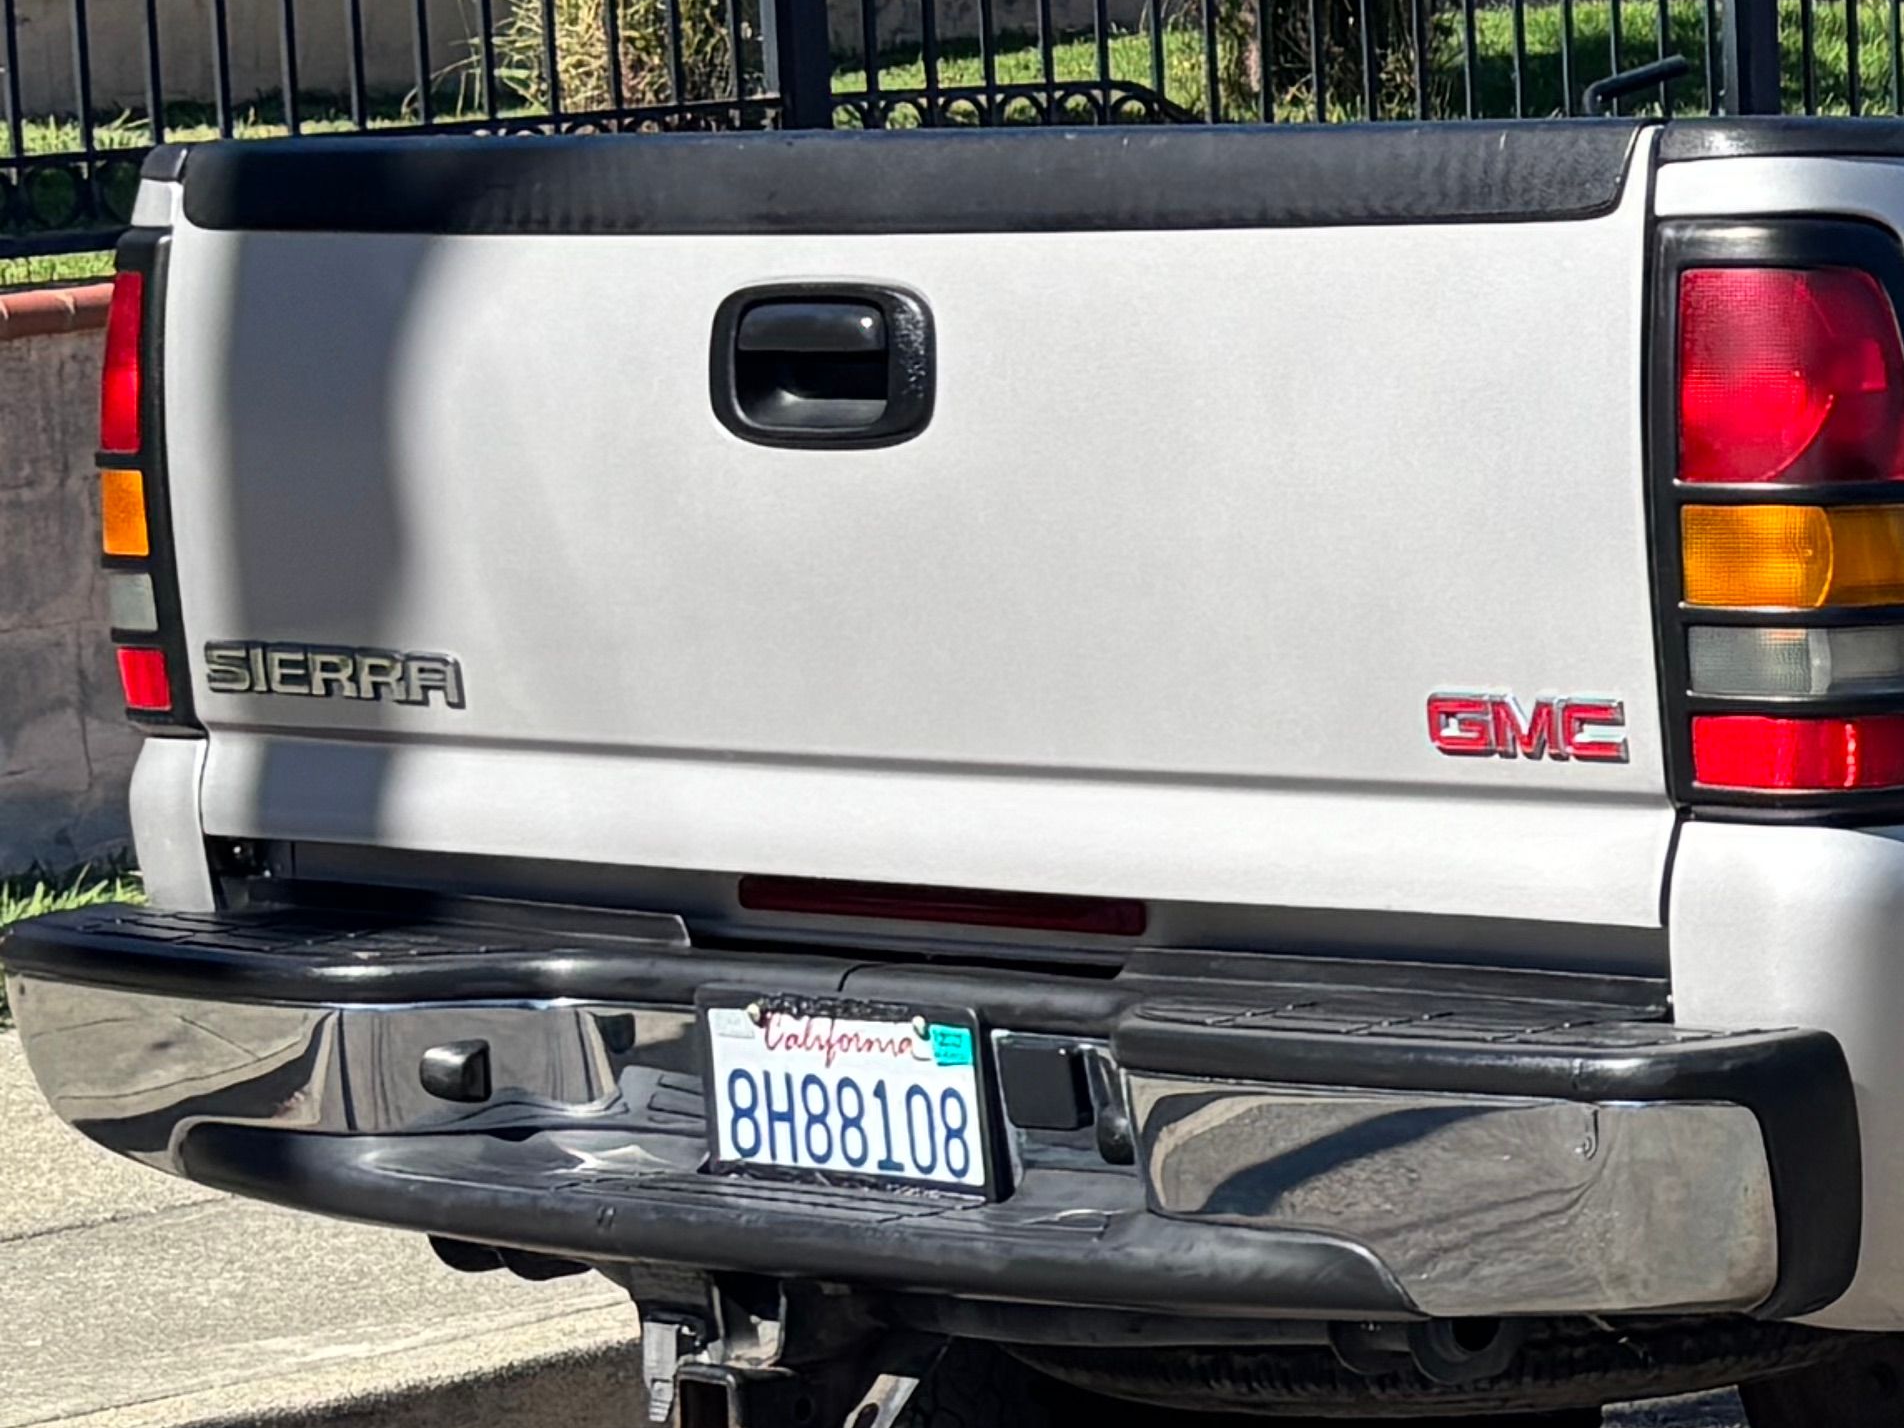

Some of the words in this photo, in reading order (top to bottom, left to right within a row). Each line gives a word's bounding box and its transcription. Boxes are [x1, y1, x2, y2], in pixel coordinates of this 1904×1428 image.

[204, 639, 466, 709] SIERRA
[1427, 691, 1629, 763] GMC
[763, 1011, 933, 1068] California
[727, 1067, 971, 1179] 8H88108
